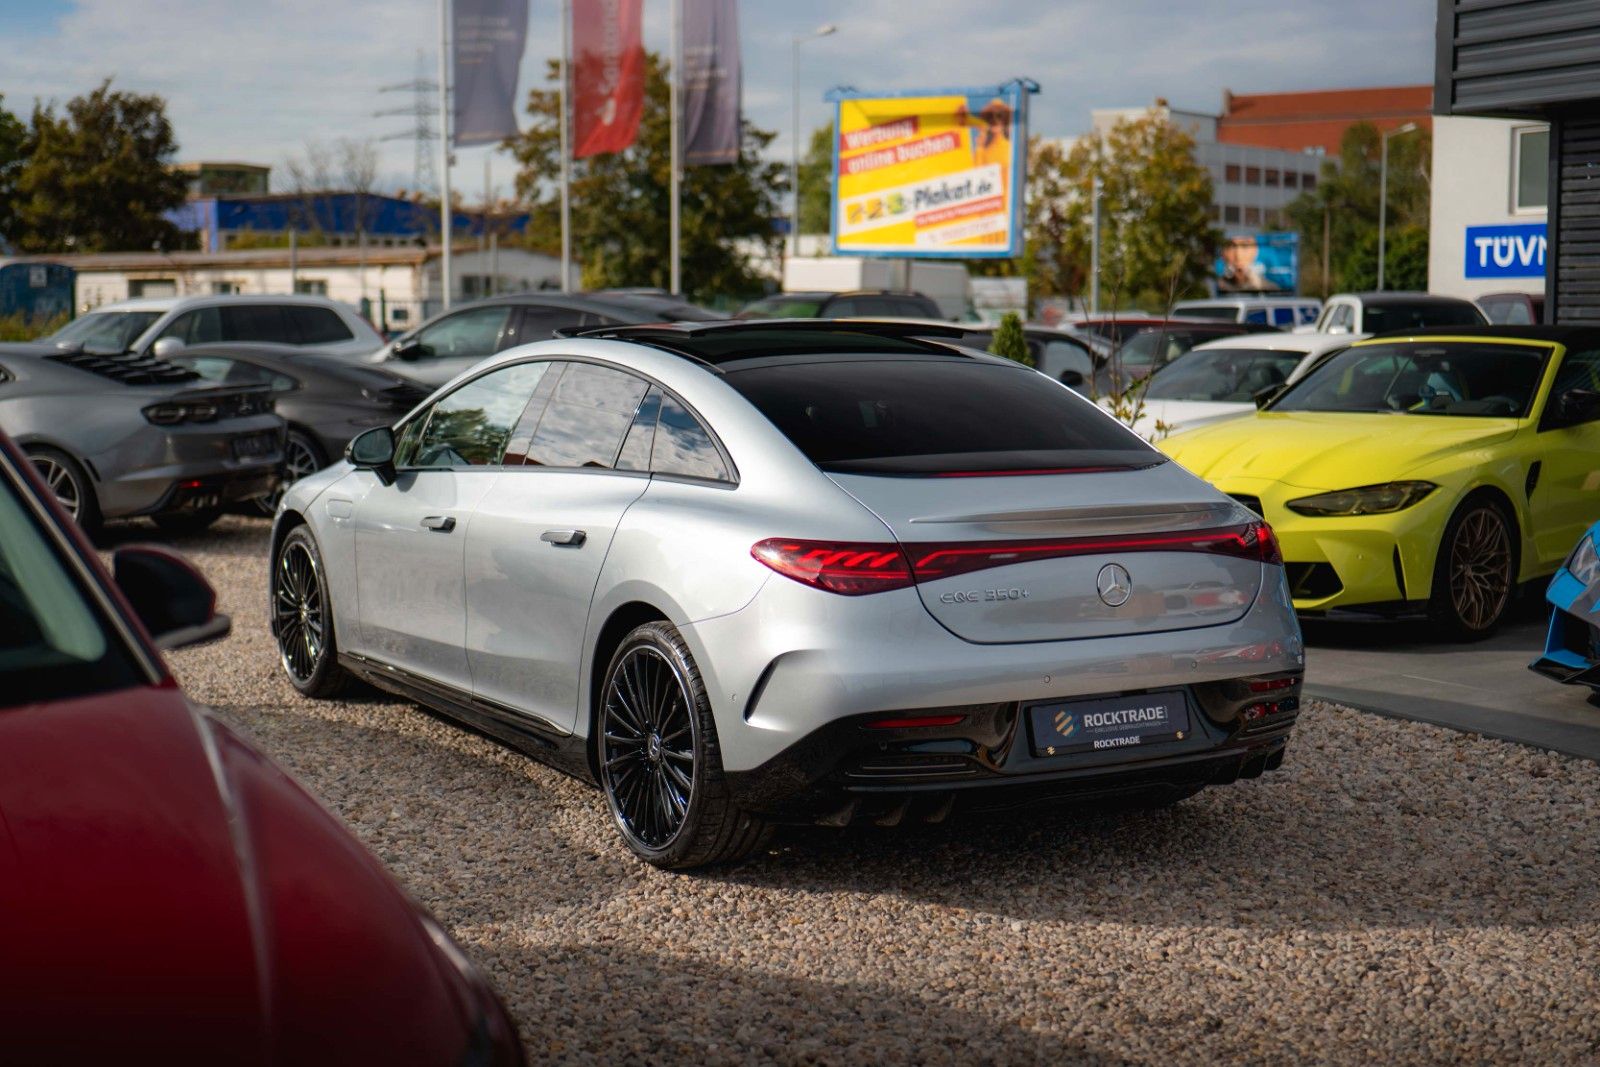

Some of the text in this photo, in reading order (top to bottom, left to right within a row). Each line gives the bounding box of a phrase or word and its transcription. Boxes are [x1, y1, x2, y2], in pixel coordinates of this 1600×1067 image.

[849, 134, 955, 174] online buchen
[940, 590, 979, 604] EQE
[1084, 706, 1164, 728] ROCKTRADE
[1093, 735, 1140, 749] ROCKTRADE
